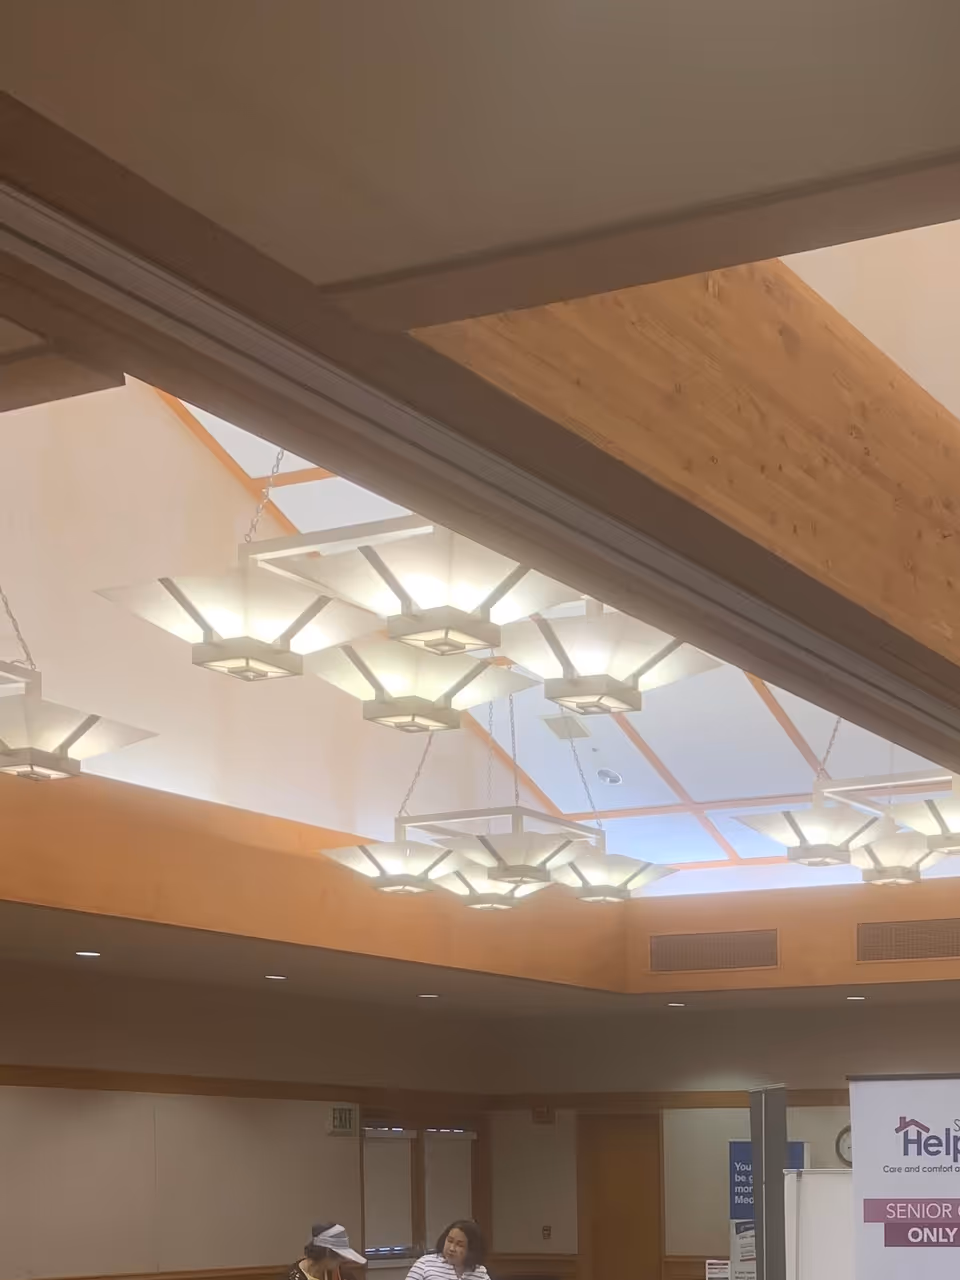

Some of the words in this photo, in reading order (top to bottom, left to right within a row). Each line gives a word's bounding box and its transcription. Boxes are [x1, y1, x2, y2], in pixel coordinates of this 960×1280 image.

[882, 1164, 902, 1173] Care
[904, 1164, 920, 1173] and
[921, 1164, 953, 1173] comfort
[734, 1173, 747, 1182] be
[886, 1203, 953, 1219] SENIOR
[907, 1227, 959, 1243] ONLY
